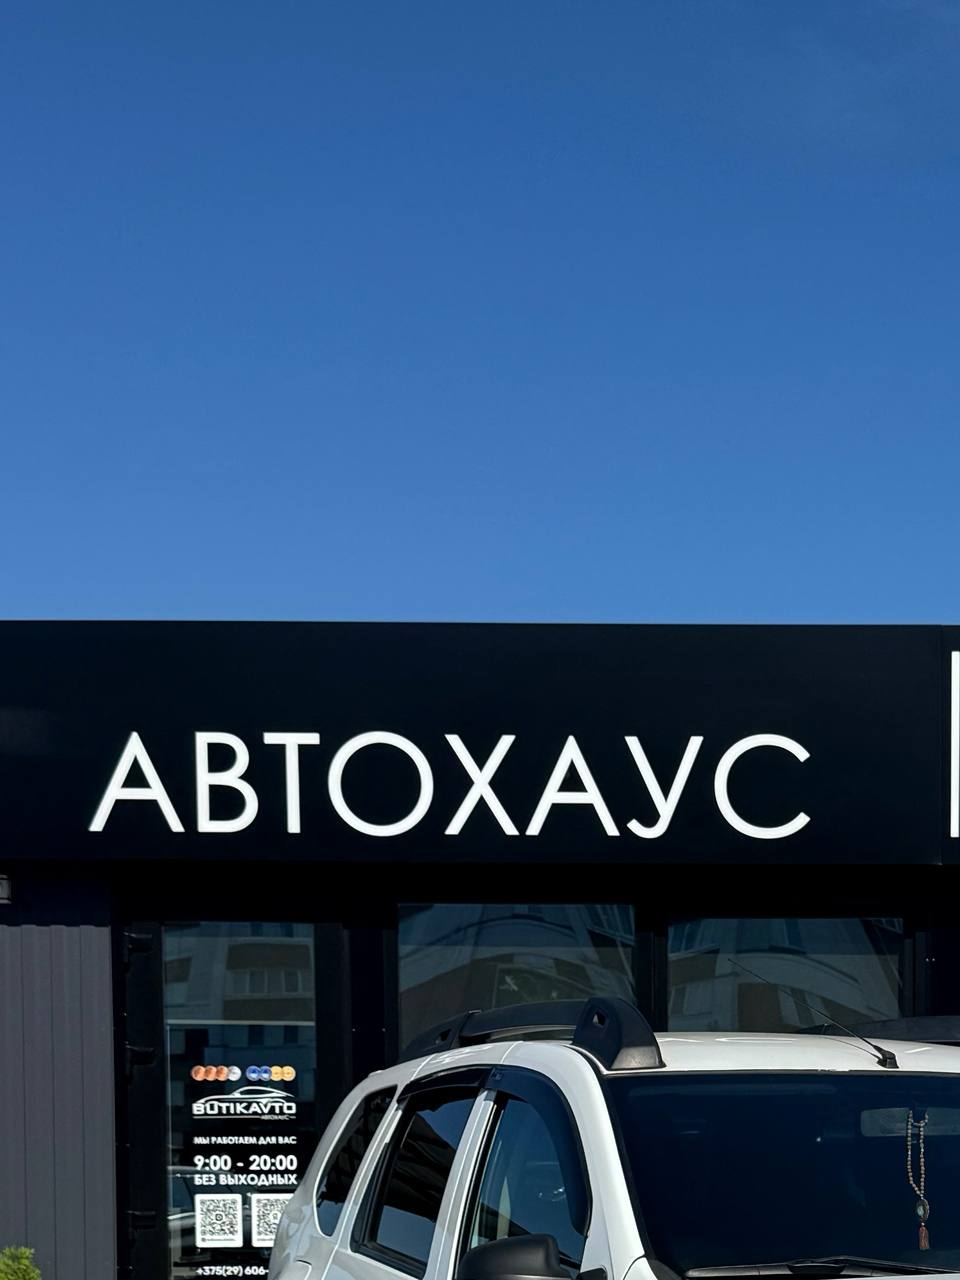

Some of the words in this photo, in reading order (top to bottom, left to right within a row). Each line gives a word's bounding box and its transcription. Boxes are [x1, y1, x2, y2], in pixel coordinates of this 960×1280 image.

[88, 731, 811, 839] АВТОХАУС
[192, 1102, 297, 1115] BUTIKAVTO
[193, 1136, 210, 1145] МЫ
[211, 1136, 257, 1145] РАБОТАЕМ
[258, 1136, 277, 1145] ДЛЯ
[278, 1136, 297, 1145] ВАС
[193, 1155, 232, 1171] 9:00
[249, 1155, 298, 1171] 20:00
[194, 1173, 216, 1185] БЕЗ
[219, 1173, 298, 1186] ВЫХОДНЫХ
[196, 1265, 243, 1277] +375(29)
